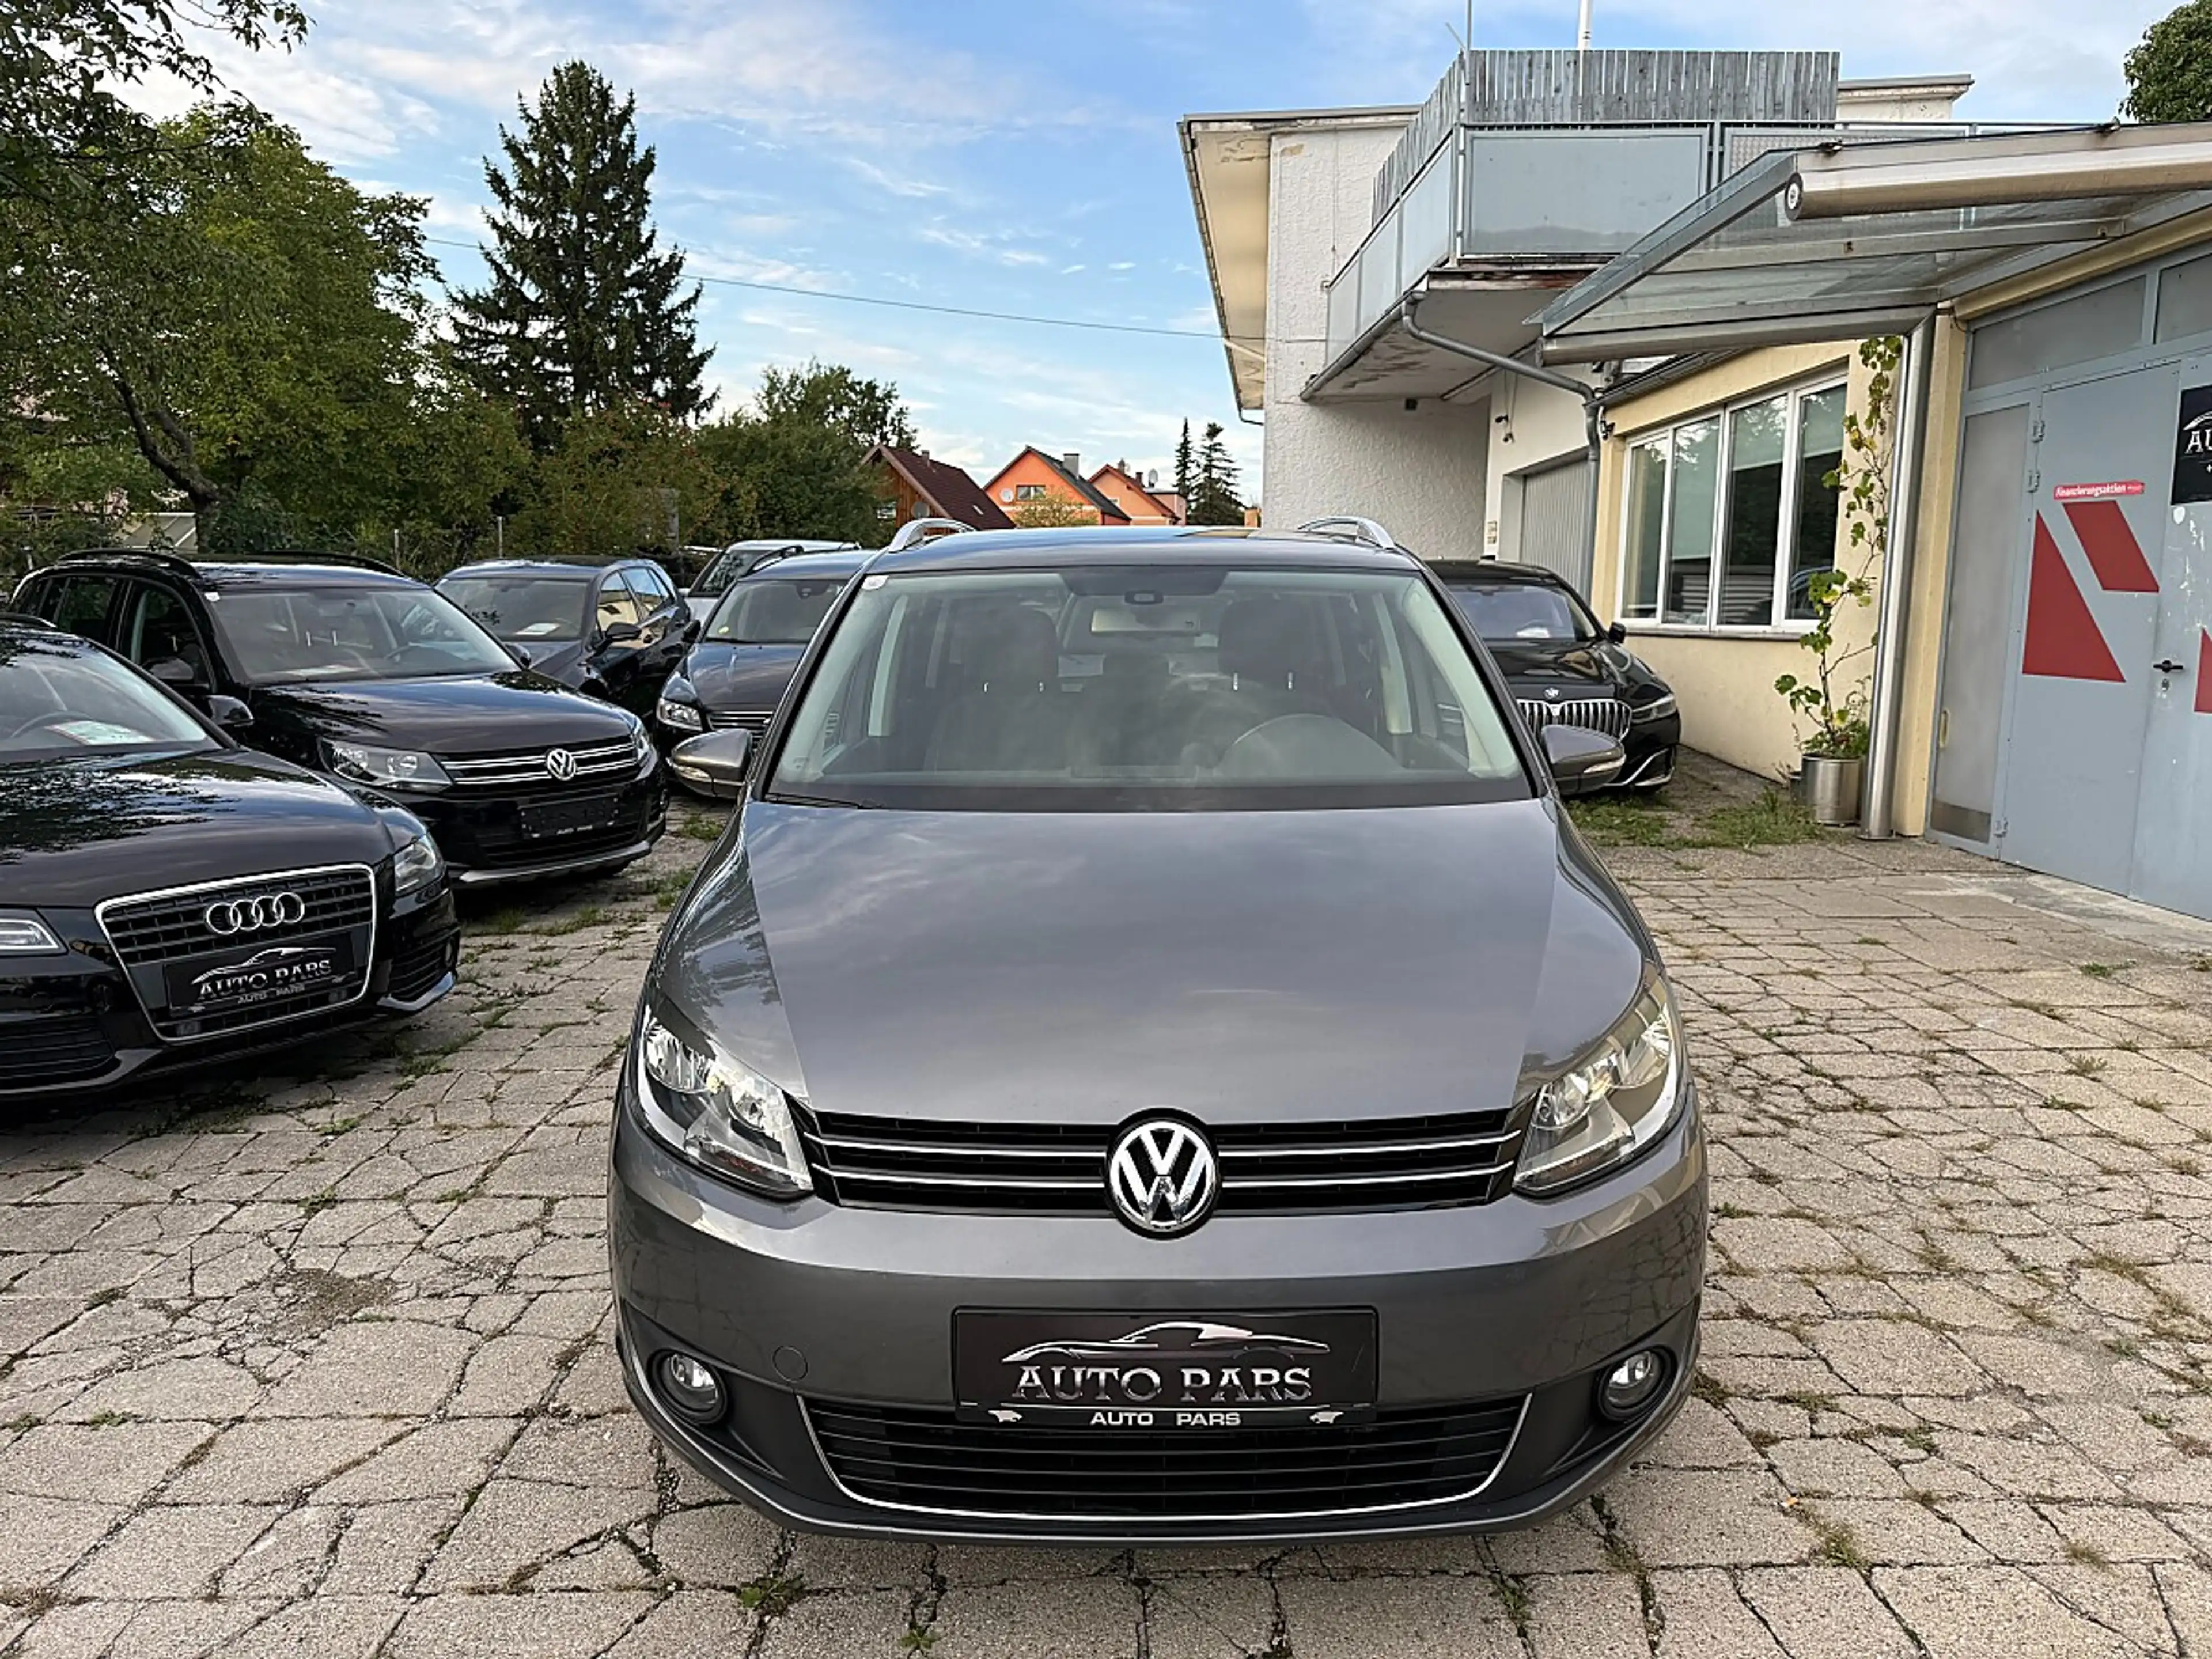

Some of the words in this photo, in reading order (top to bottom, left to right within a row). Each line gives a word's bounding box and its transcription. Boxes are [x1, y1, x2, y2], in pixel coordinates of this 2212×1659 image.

[198, 972, 268, 1001] AUTO
[275, 960, 331, 985] PARS
[1011, 1365, 1162, 1402] AUTO
[1180, 1366, 1312, 1402] PARS
[1090, 1412, 1153, 1426] AUTO
[1176, 1412, 1241, 1426] PARS
